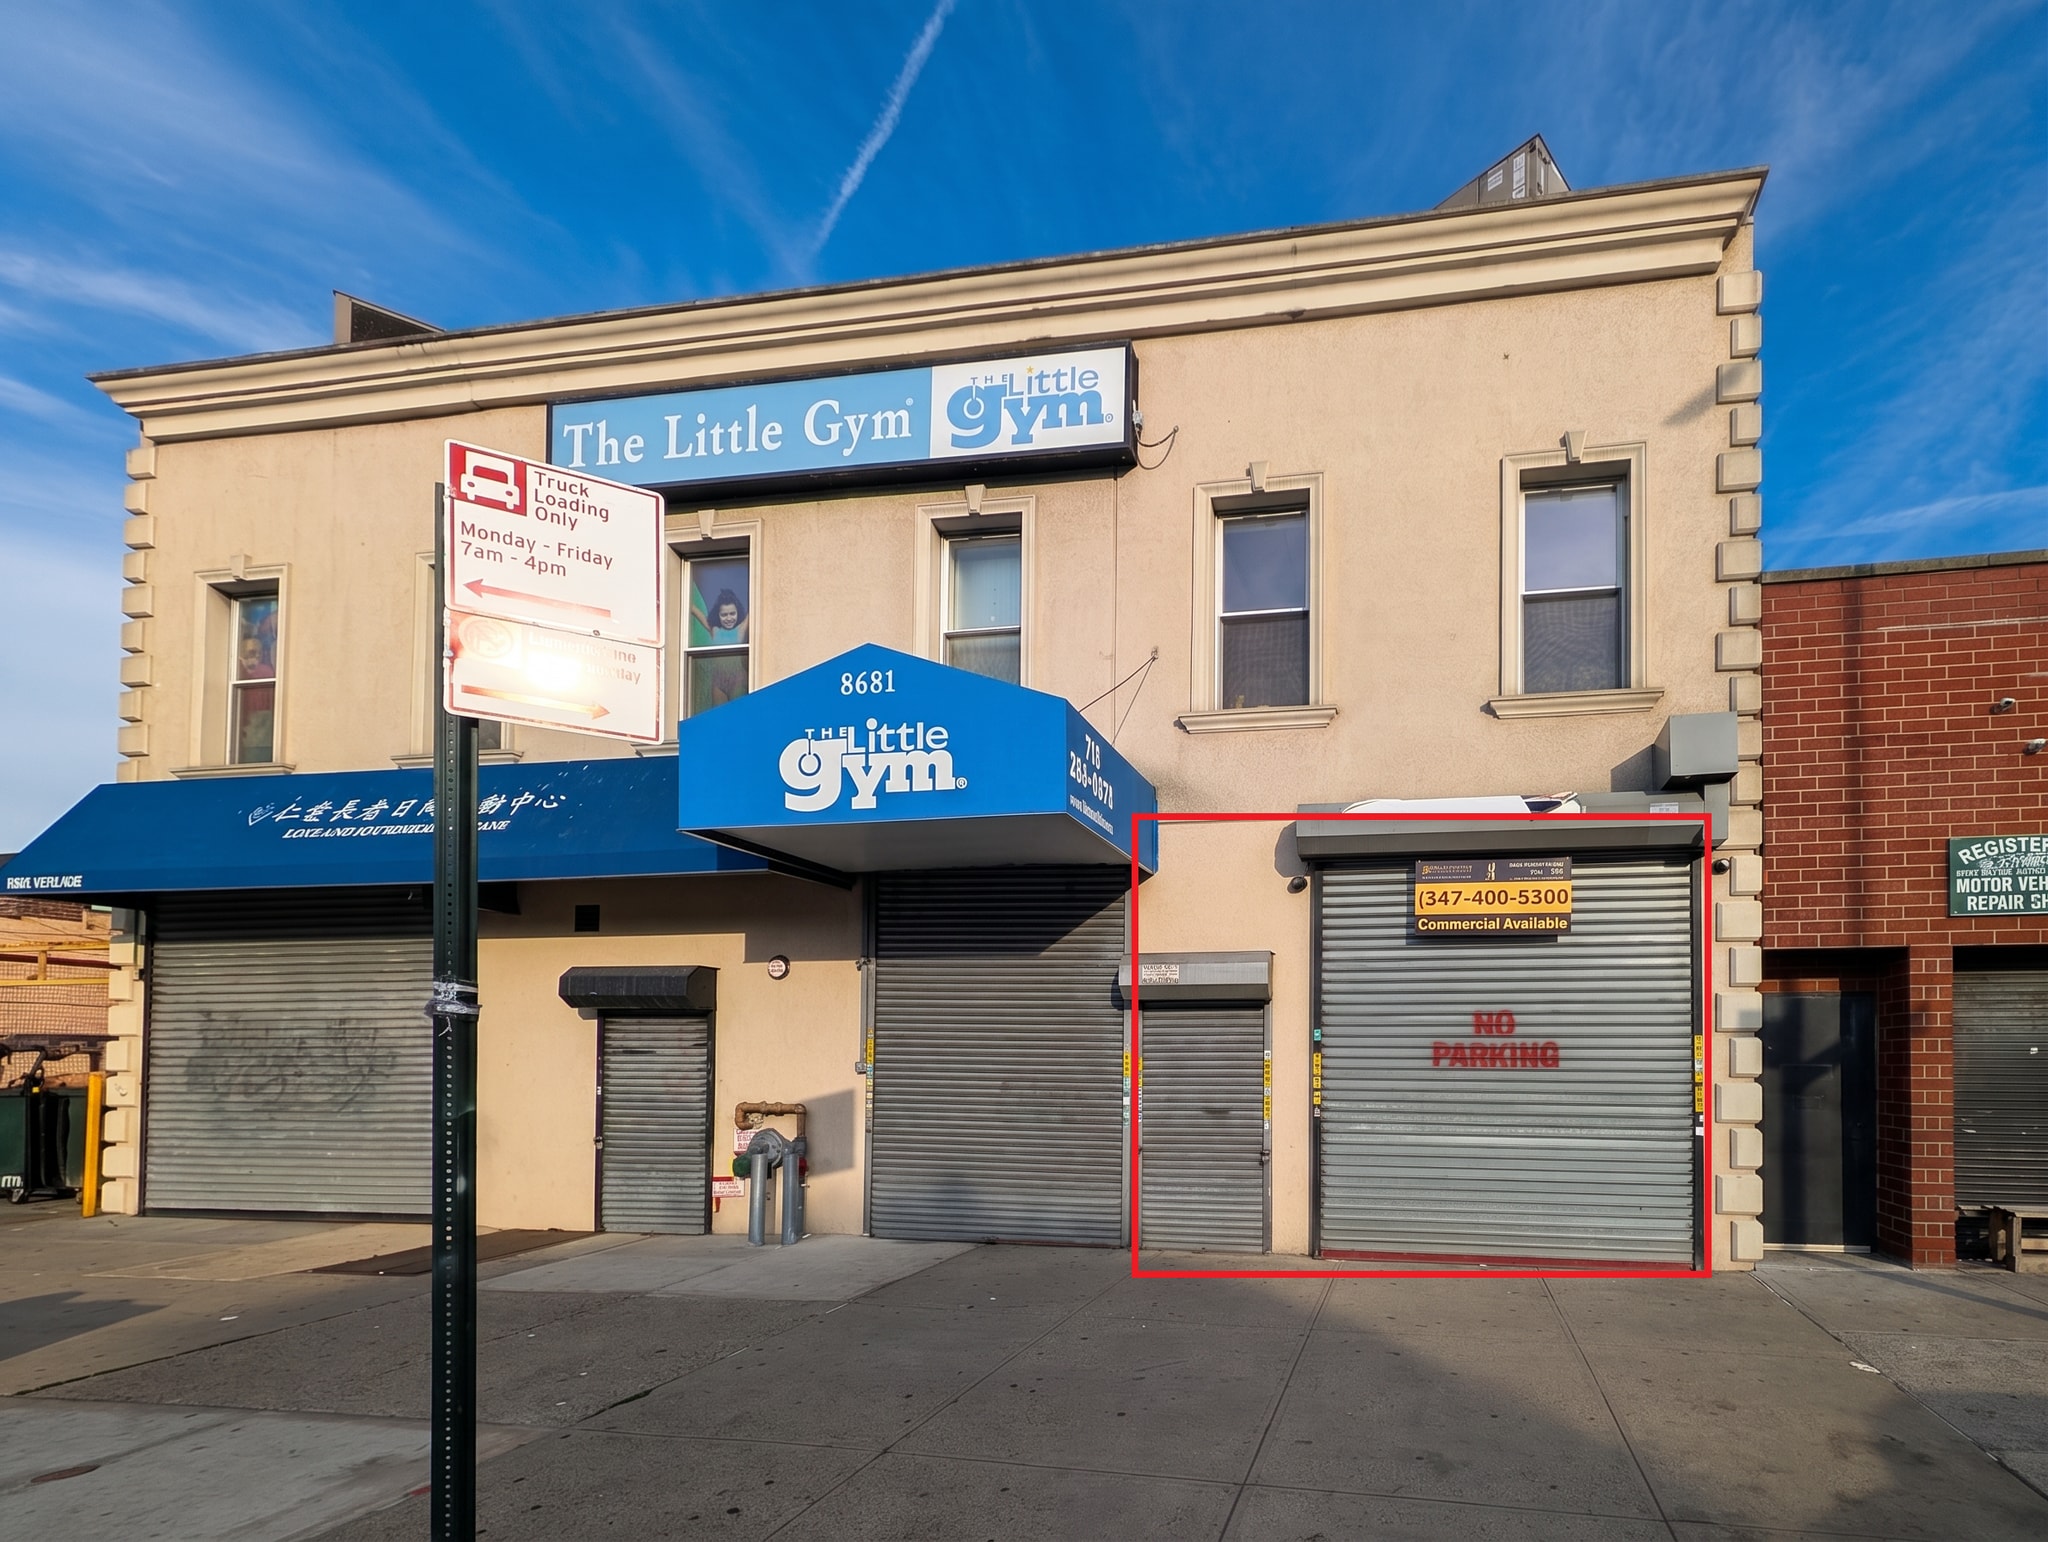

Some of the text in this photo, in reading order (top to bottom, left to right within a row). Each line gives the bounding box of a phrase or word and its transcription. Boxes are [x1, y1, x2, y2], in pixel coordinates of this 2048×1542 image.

[971, 365, 1100, 397] THE Little
[946, 384, 1105, 449] gym
[563, 399, 912, 468] The Little Gym
[534, 471, 590, 498] Truck
[534, 488, 610, 523] Loading
[535, 506, 578, 531] Only
[460, 521, 536, 554] Monday
[557, 542, 613, 570] Friday
[460, 540, 503, 564] 7am
[524, 556, 567, 577] 4pm
[840, 669, 896, 696] 8681
[805, 717, 949, 753] THE Little
[778, 738, 957, 812] gym
[1956, 875, 2048, 893] MOTOR VEH
[1419, 889, 1569, 909] (347-400-5300
[1967, 894, 2025, 911] REPAIR
[1418, 916, 1568, 931] Commercial Available
[1472, 1009, 1516, 1035] NO
[1432, 1041, 1560, 1068] PARKING
